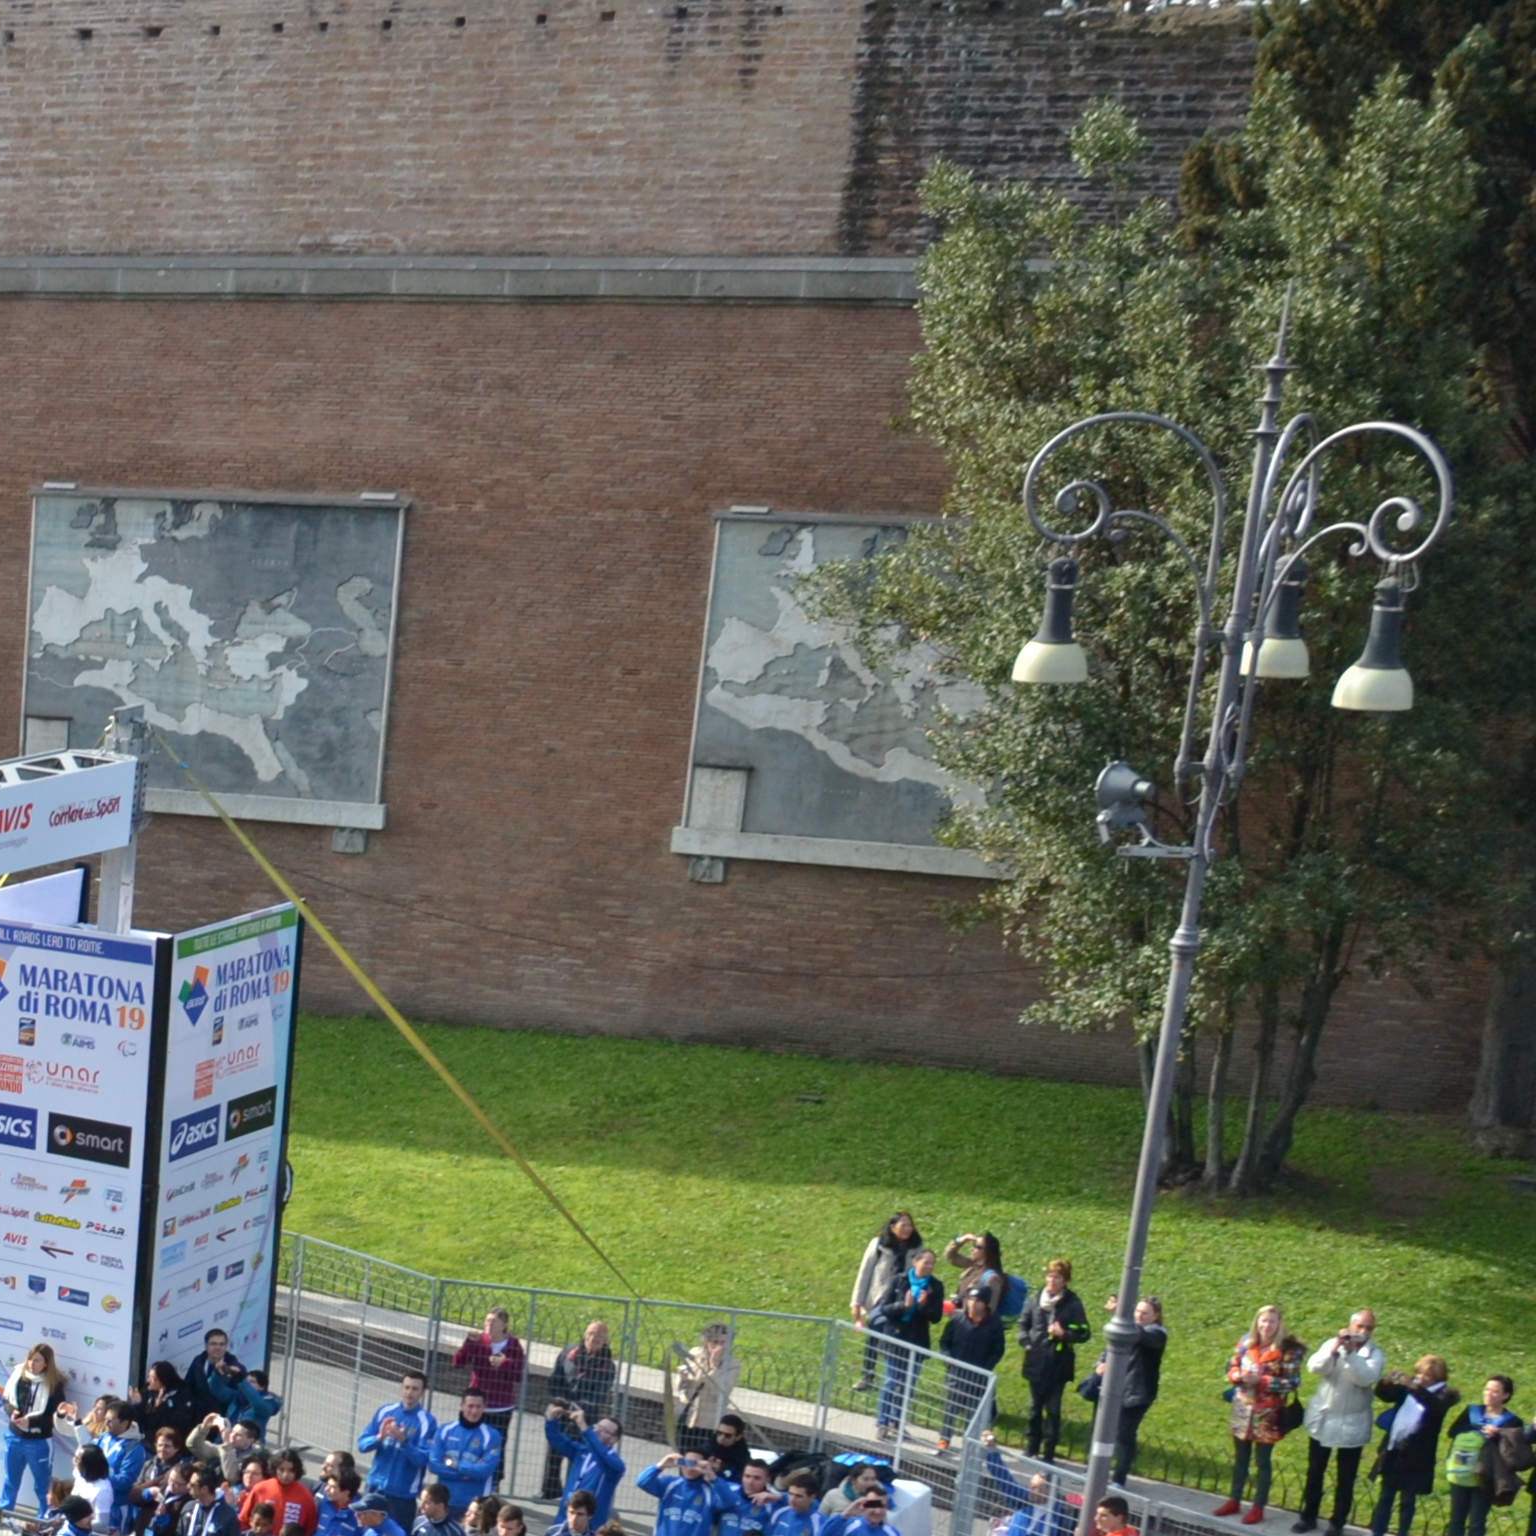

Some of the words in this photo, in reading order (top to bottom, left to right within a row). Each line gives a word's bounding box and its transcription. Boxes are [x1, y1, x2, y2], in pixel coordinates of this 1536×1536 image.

[13, 930, 40, 945] ROADS
[42, 934, 63, 948] LEAD
[65, 938, 76, 949] TO
[216, 944, 290, 987] MARATONA
[19, 963, 146, 1005] MARATONA
[214, 988, 227, 1014] di
[229, 975, 270, 1009] ROMA
[271, 969, 290, 995] 19
[18, 990, 39, 1014] di
[45, 994, 112, 1026] ROMA
[116, 1005, 146, 1031] 19
[228, 1043, 260, 1066] unar
[46, 1061, 100, 1084] unar
[242, 1100, 272, 1122] smart
[75, 1131, 124, 1153] smart
[186, 1117, 217, 1146] asics
[3, 1232, 28, 1246] AVIS
[85, 1221, 125, 1237] POLAR
